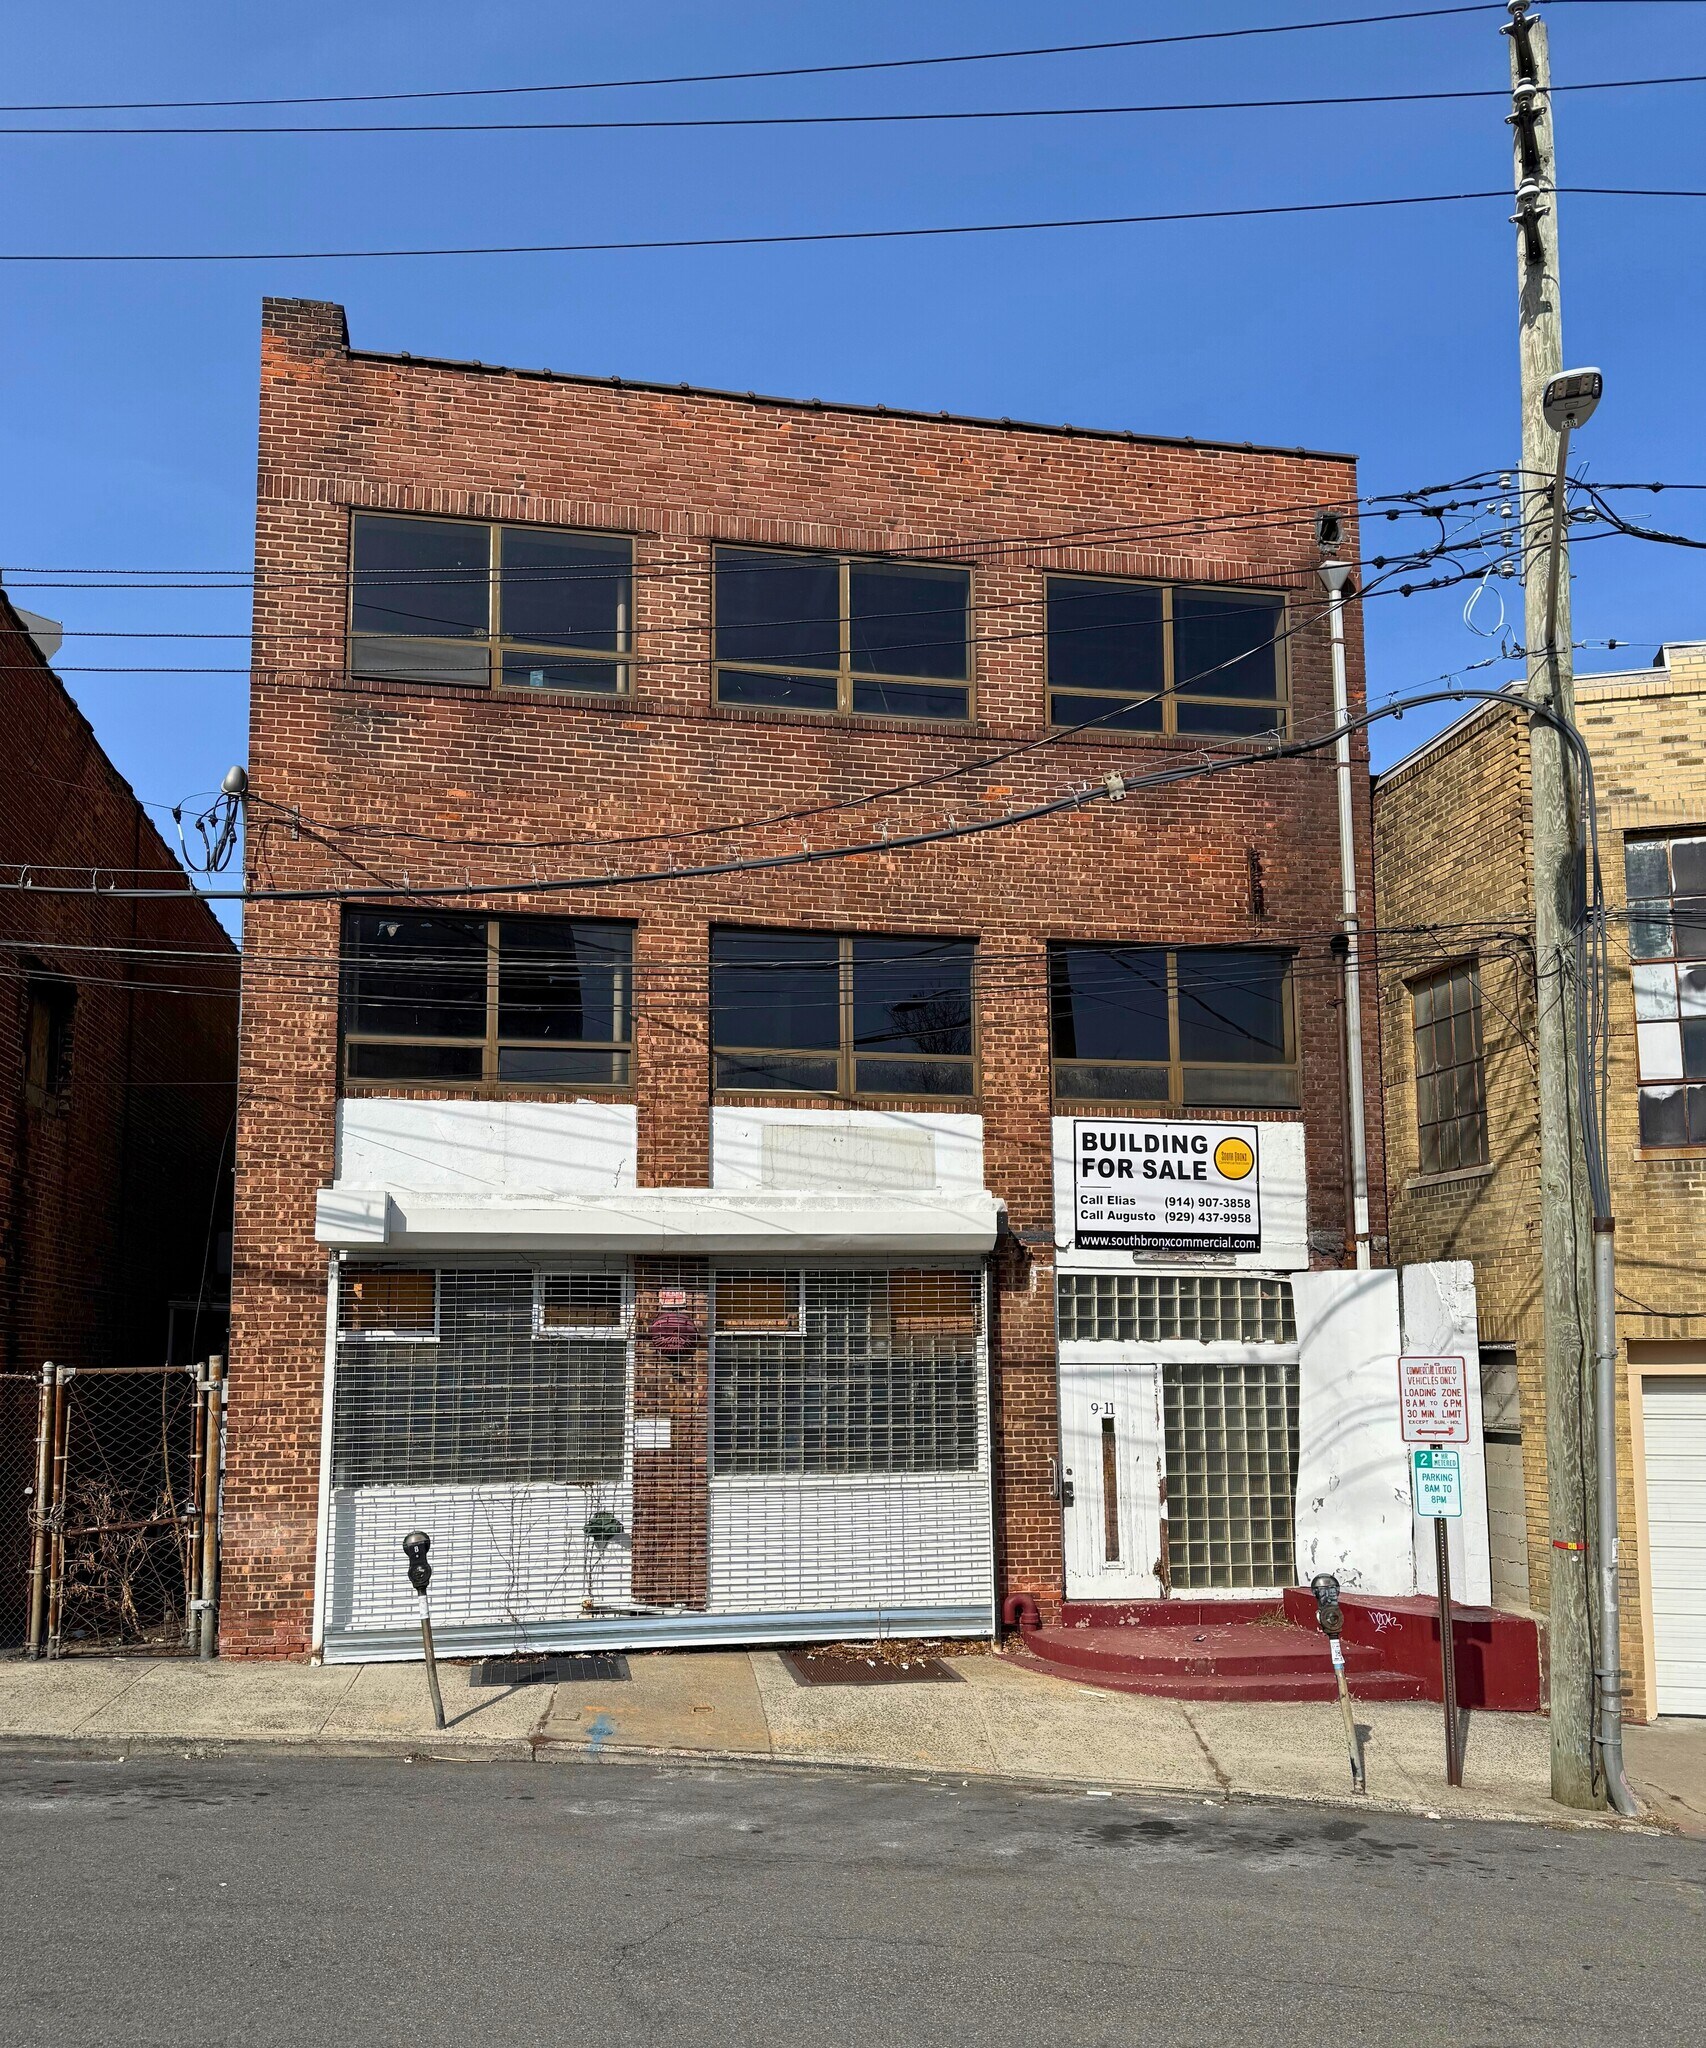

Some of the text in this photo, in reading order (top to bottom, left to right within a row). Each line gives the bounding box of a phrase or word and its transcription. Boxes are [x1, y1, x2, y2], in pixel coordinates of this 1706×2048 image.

[1082, 1132, 1208, 1154] BUILDING
[1082, 1158, 1208, 1180] FOR SALE
[1080, 1195, 1251, 1210] Call Elias (914) 907-3858
[1080, 1209, 1252, 1224] Call Augusto (929) 437-9958
[1080, 1233, 1256, 1249] www.southbronxcommercial.com
[1435, 1366, 1457, 1375] LICENSED
[1407, 1376, 1457, 1385] VEHICLES ONLY
[1404, 1388, 1462, 1397] LOADING ZONE
[1405, 1399, 1411, 1407] 8
[1443, 1399, 1449, 1407] 6
[1091, 1402, 1116, 1415] 9-11
[1407, 1409, 1418, 1418] 30
[1441, 1410, 1462, 1418] LIMIT
[1420, 1453, 1428, 1466] 2
[1421, 1473, 1453, 1482] PARKING
[1424, 1484, 1452, 1493] 8AM TO
[1431, 1495, 1447, 1504] 8PM
